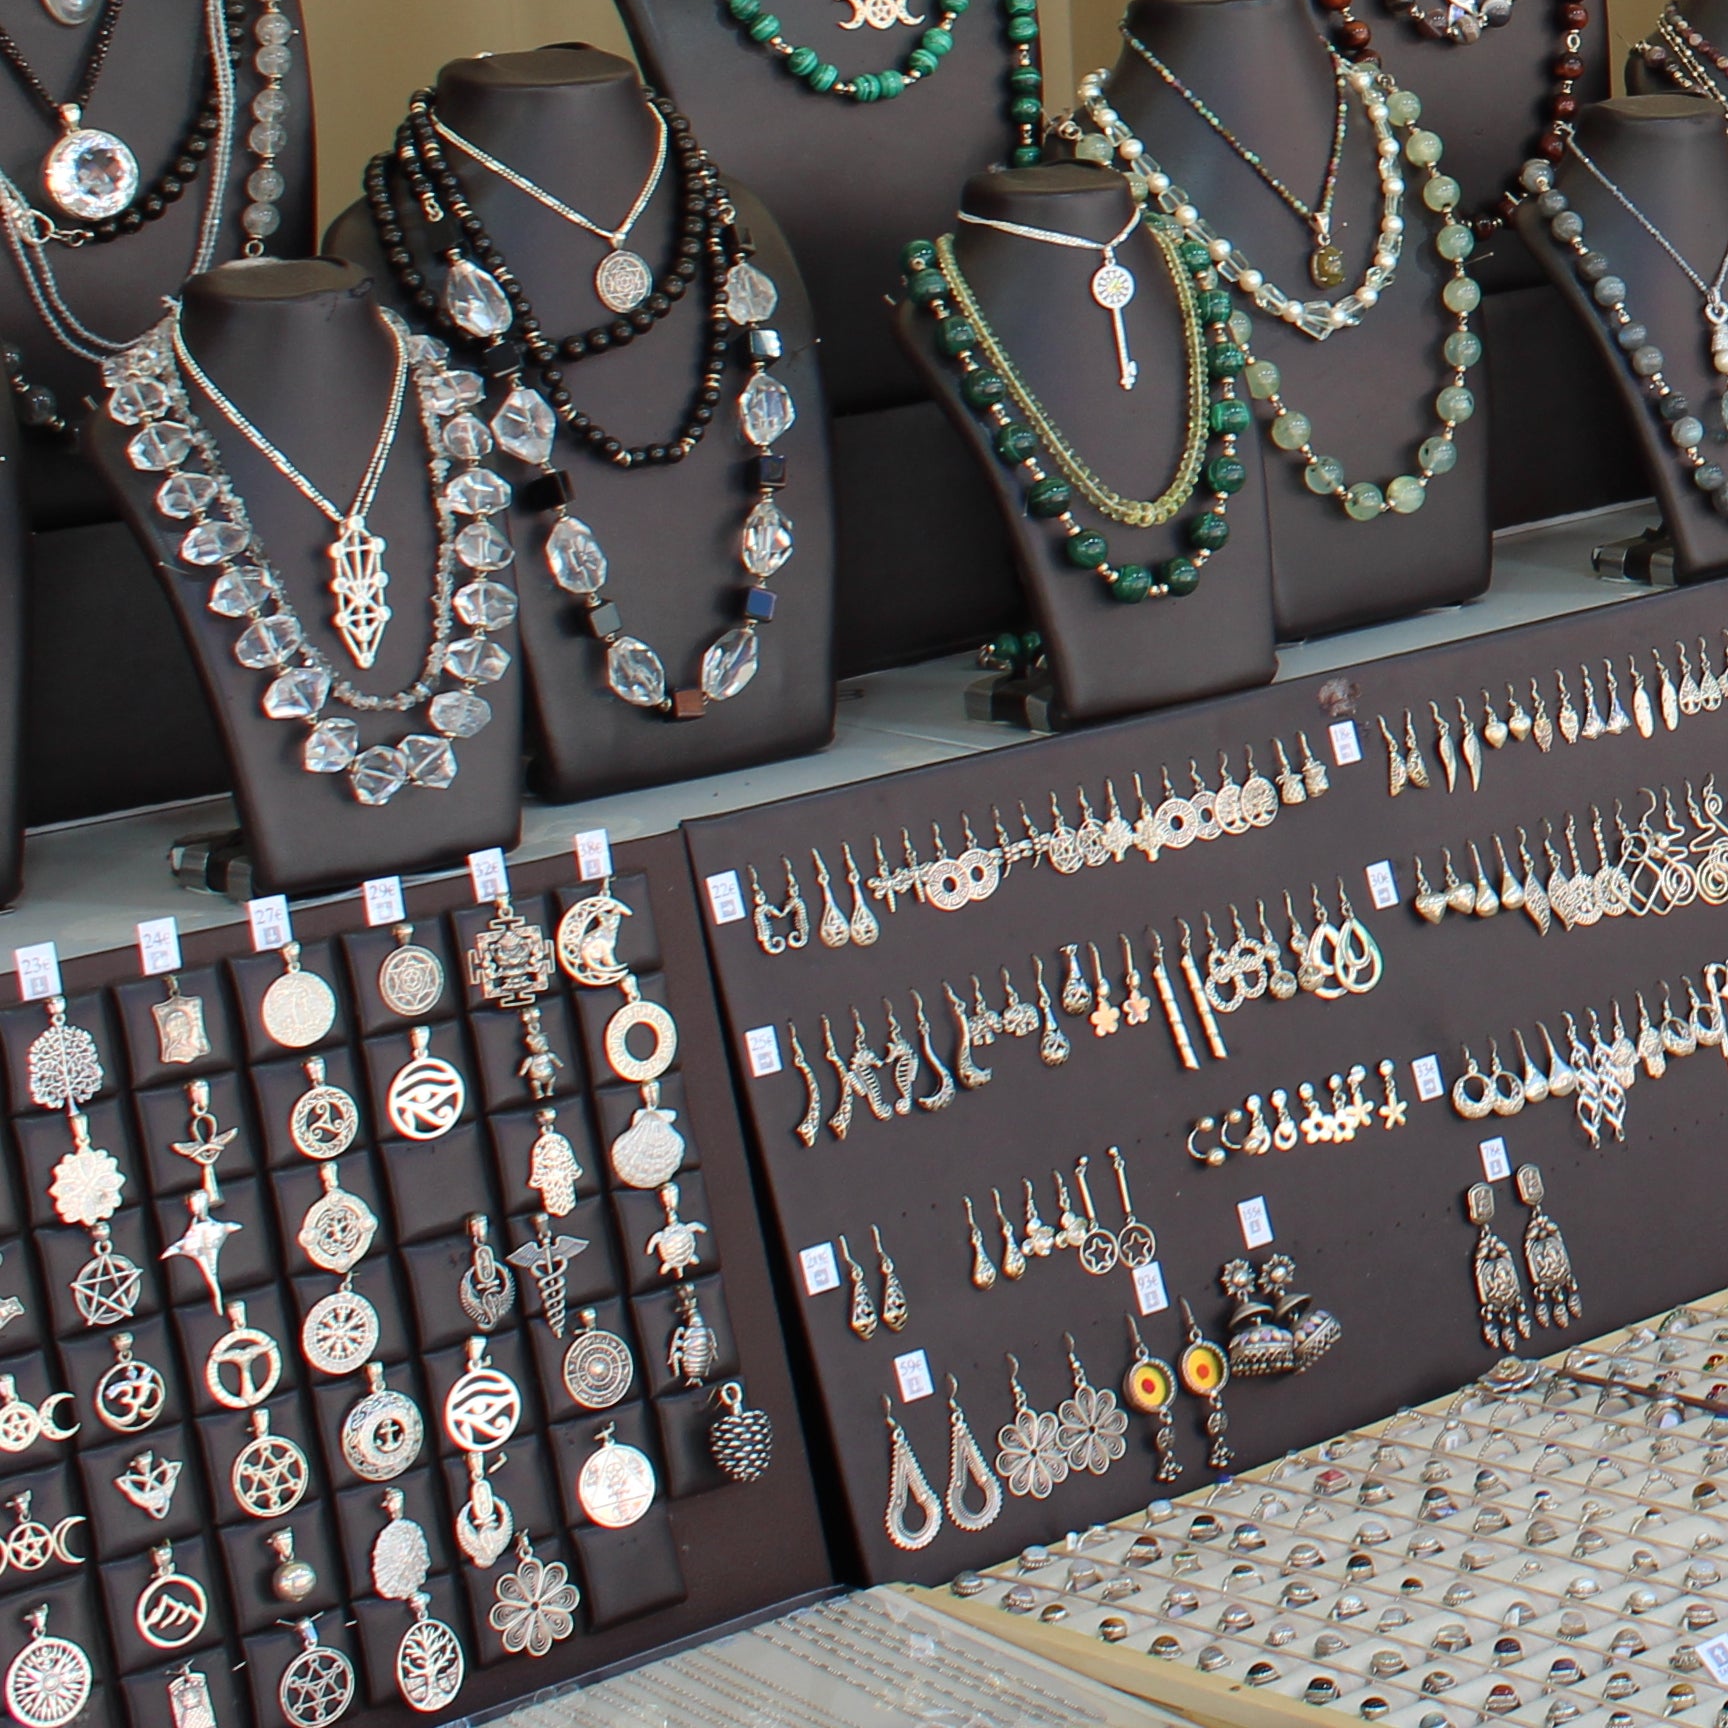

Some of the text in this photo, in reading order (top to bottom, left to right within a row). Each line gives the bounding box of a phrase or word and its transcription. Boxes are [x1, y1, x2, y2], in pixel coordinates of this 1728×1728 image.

[475, 860, 499, 877] 32€
[369, 883, 396, 900] 29€
[713, 882, 735, 899] 22€
[256, 907, 284, 925] 27€
[143, 931, 171, 949] 24€
[22, 957, 52, 975] 23€
[752, 1037, 774, 1051] 25€
[1138, 1274, 1158, 1290] 93€
[900, 1359, 921, 1374] 59€
